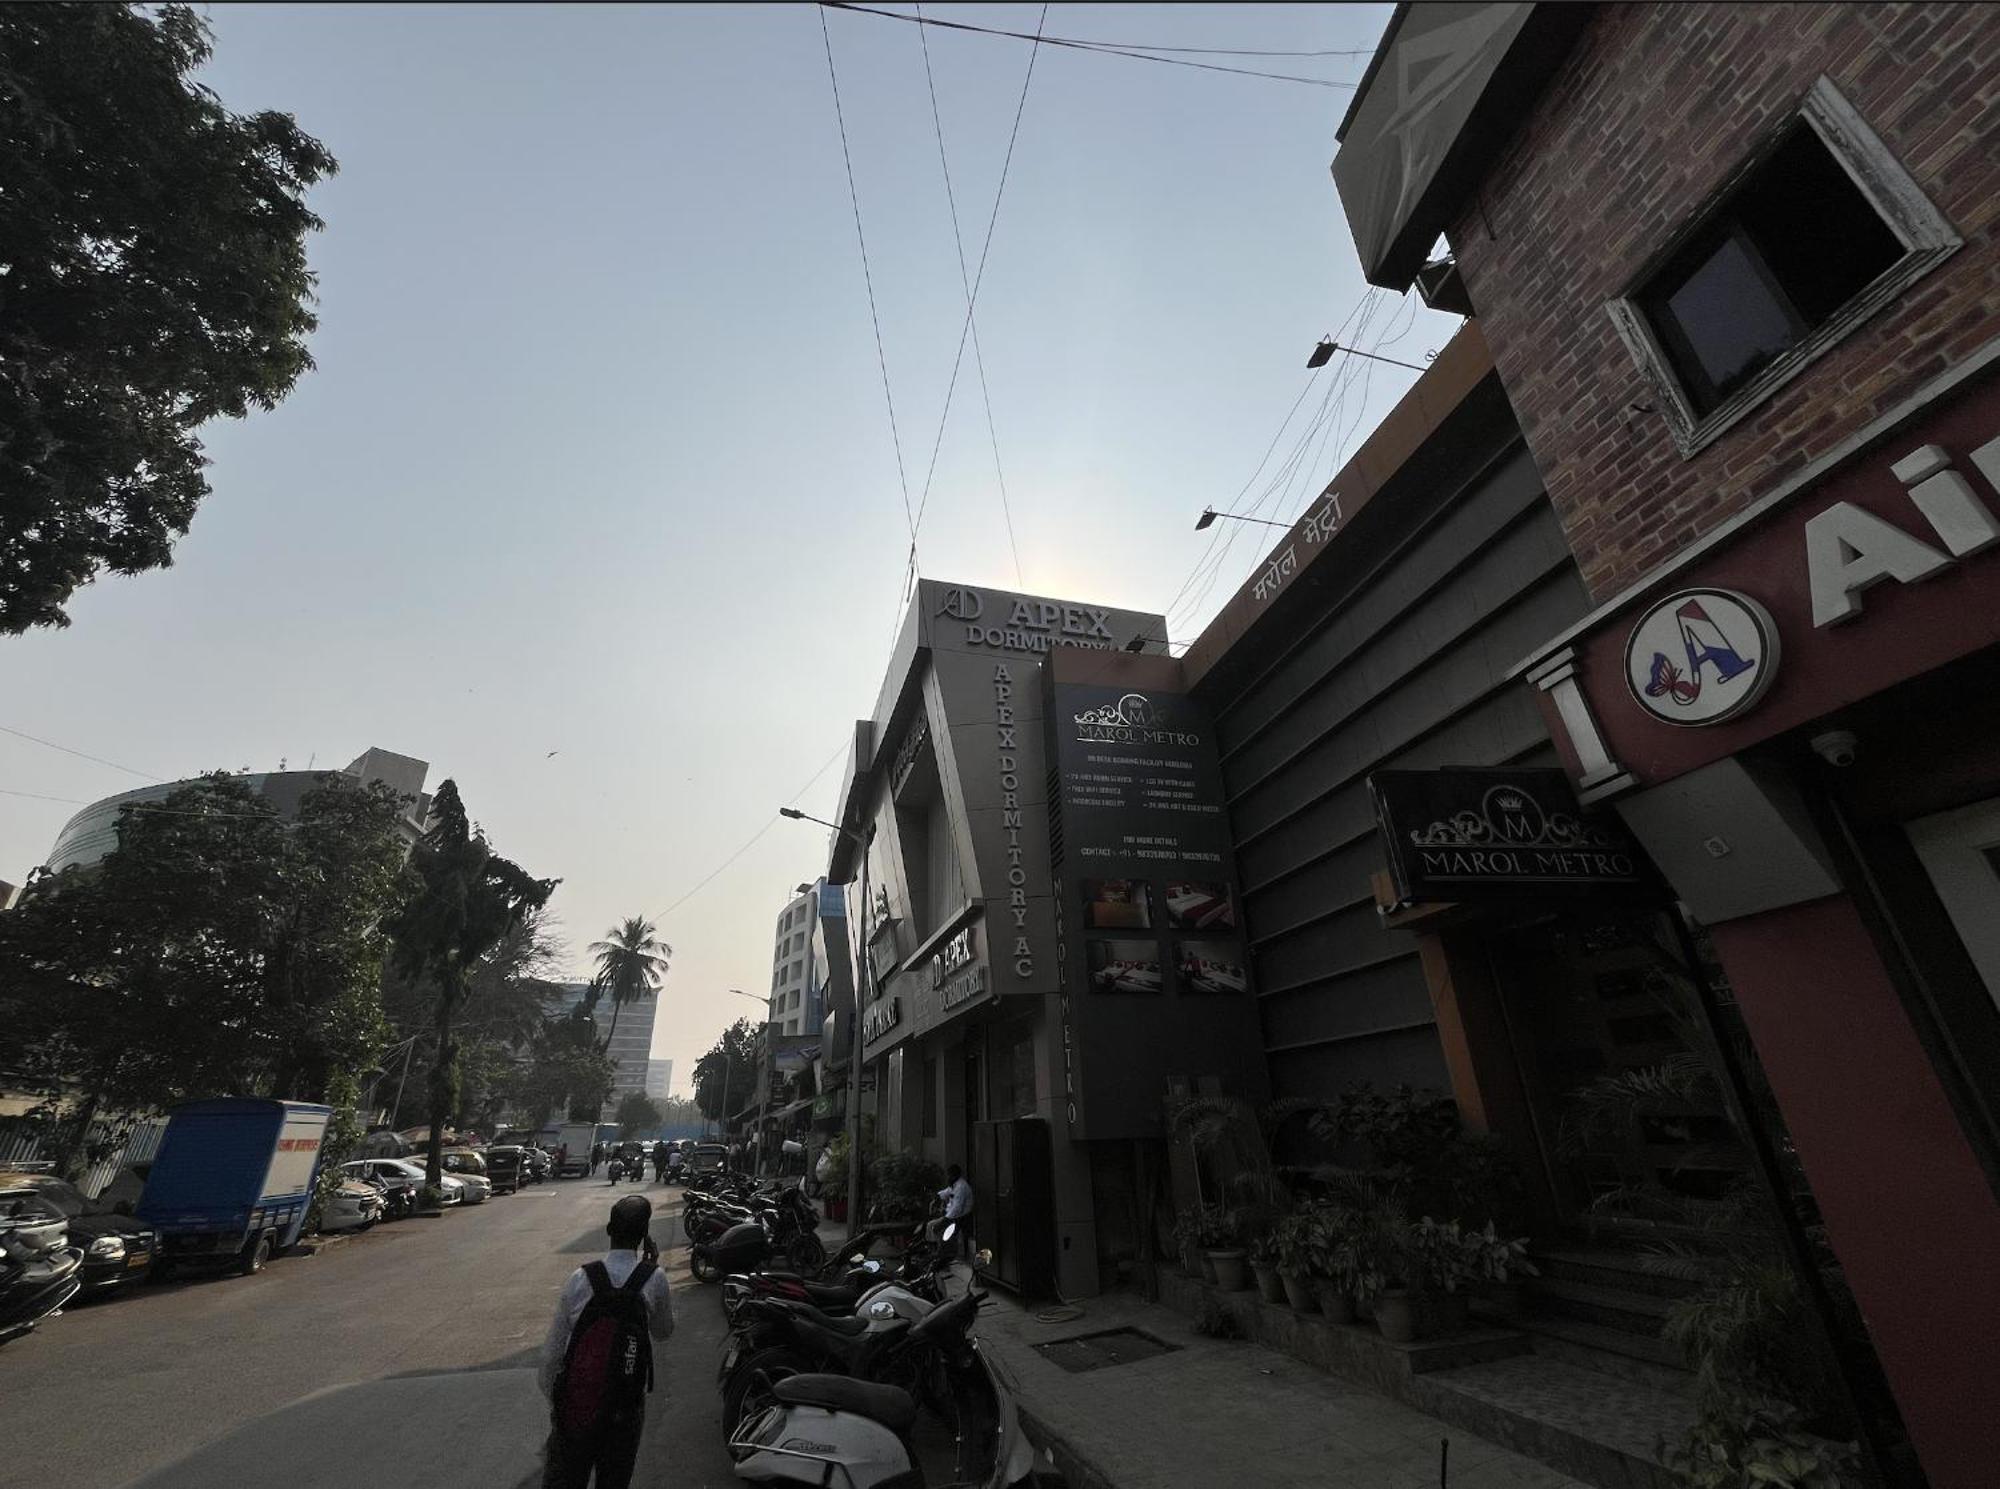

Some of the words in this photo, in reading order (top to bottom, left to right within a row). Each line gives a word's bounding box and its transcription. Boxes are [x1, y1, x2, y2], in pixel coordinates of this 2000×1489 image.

[1252, 544, 1297, 599] मरोल
[1302, 492, 1342, 543] मेट्रो
[1008, 598, 1112, 640] APEX
[993, 664, 1017, 749] APEX
[1078, 724, 1137, 741] MAROL
[1143, 730, 1200, 746] METRO
[999, 755, 1027, 928] DORMITORY
[1421, 851, 1529, 875] MAROL
[1535, 852, 1634, 876] METRO
[944, 928, 971, 976] APEX
[1014, 936, 1034, 978] AC
[624, 1335, 638, 1376] safari
